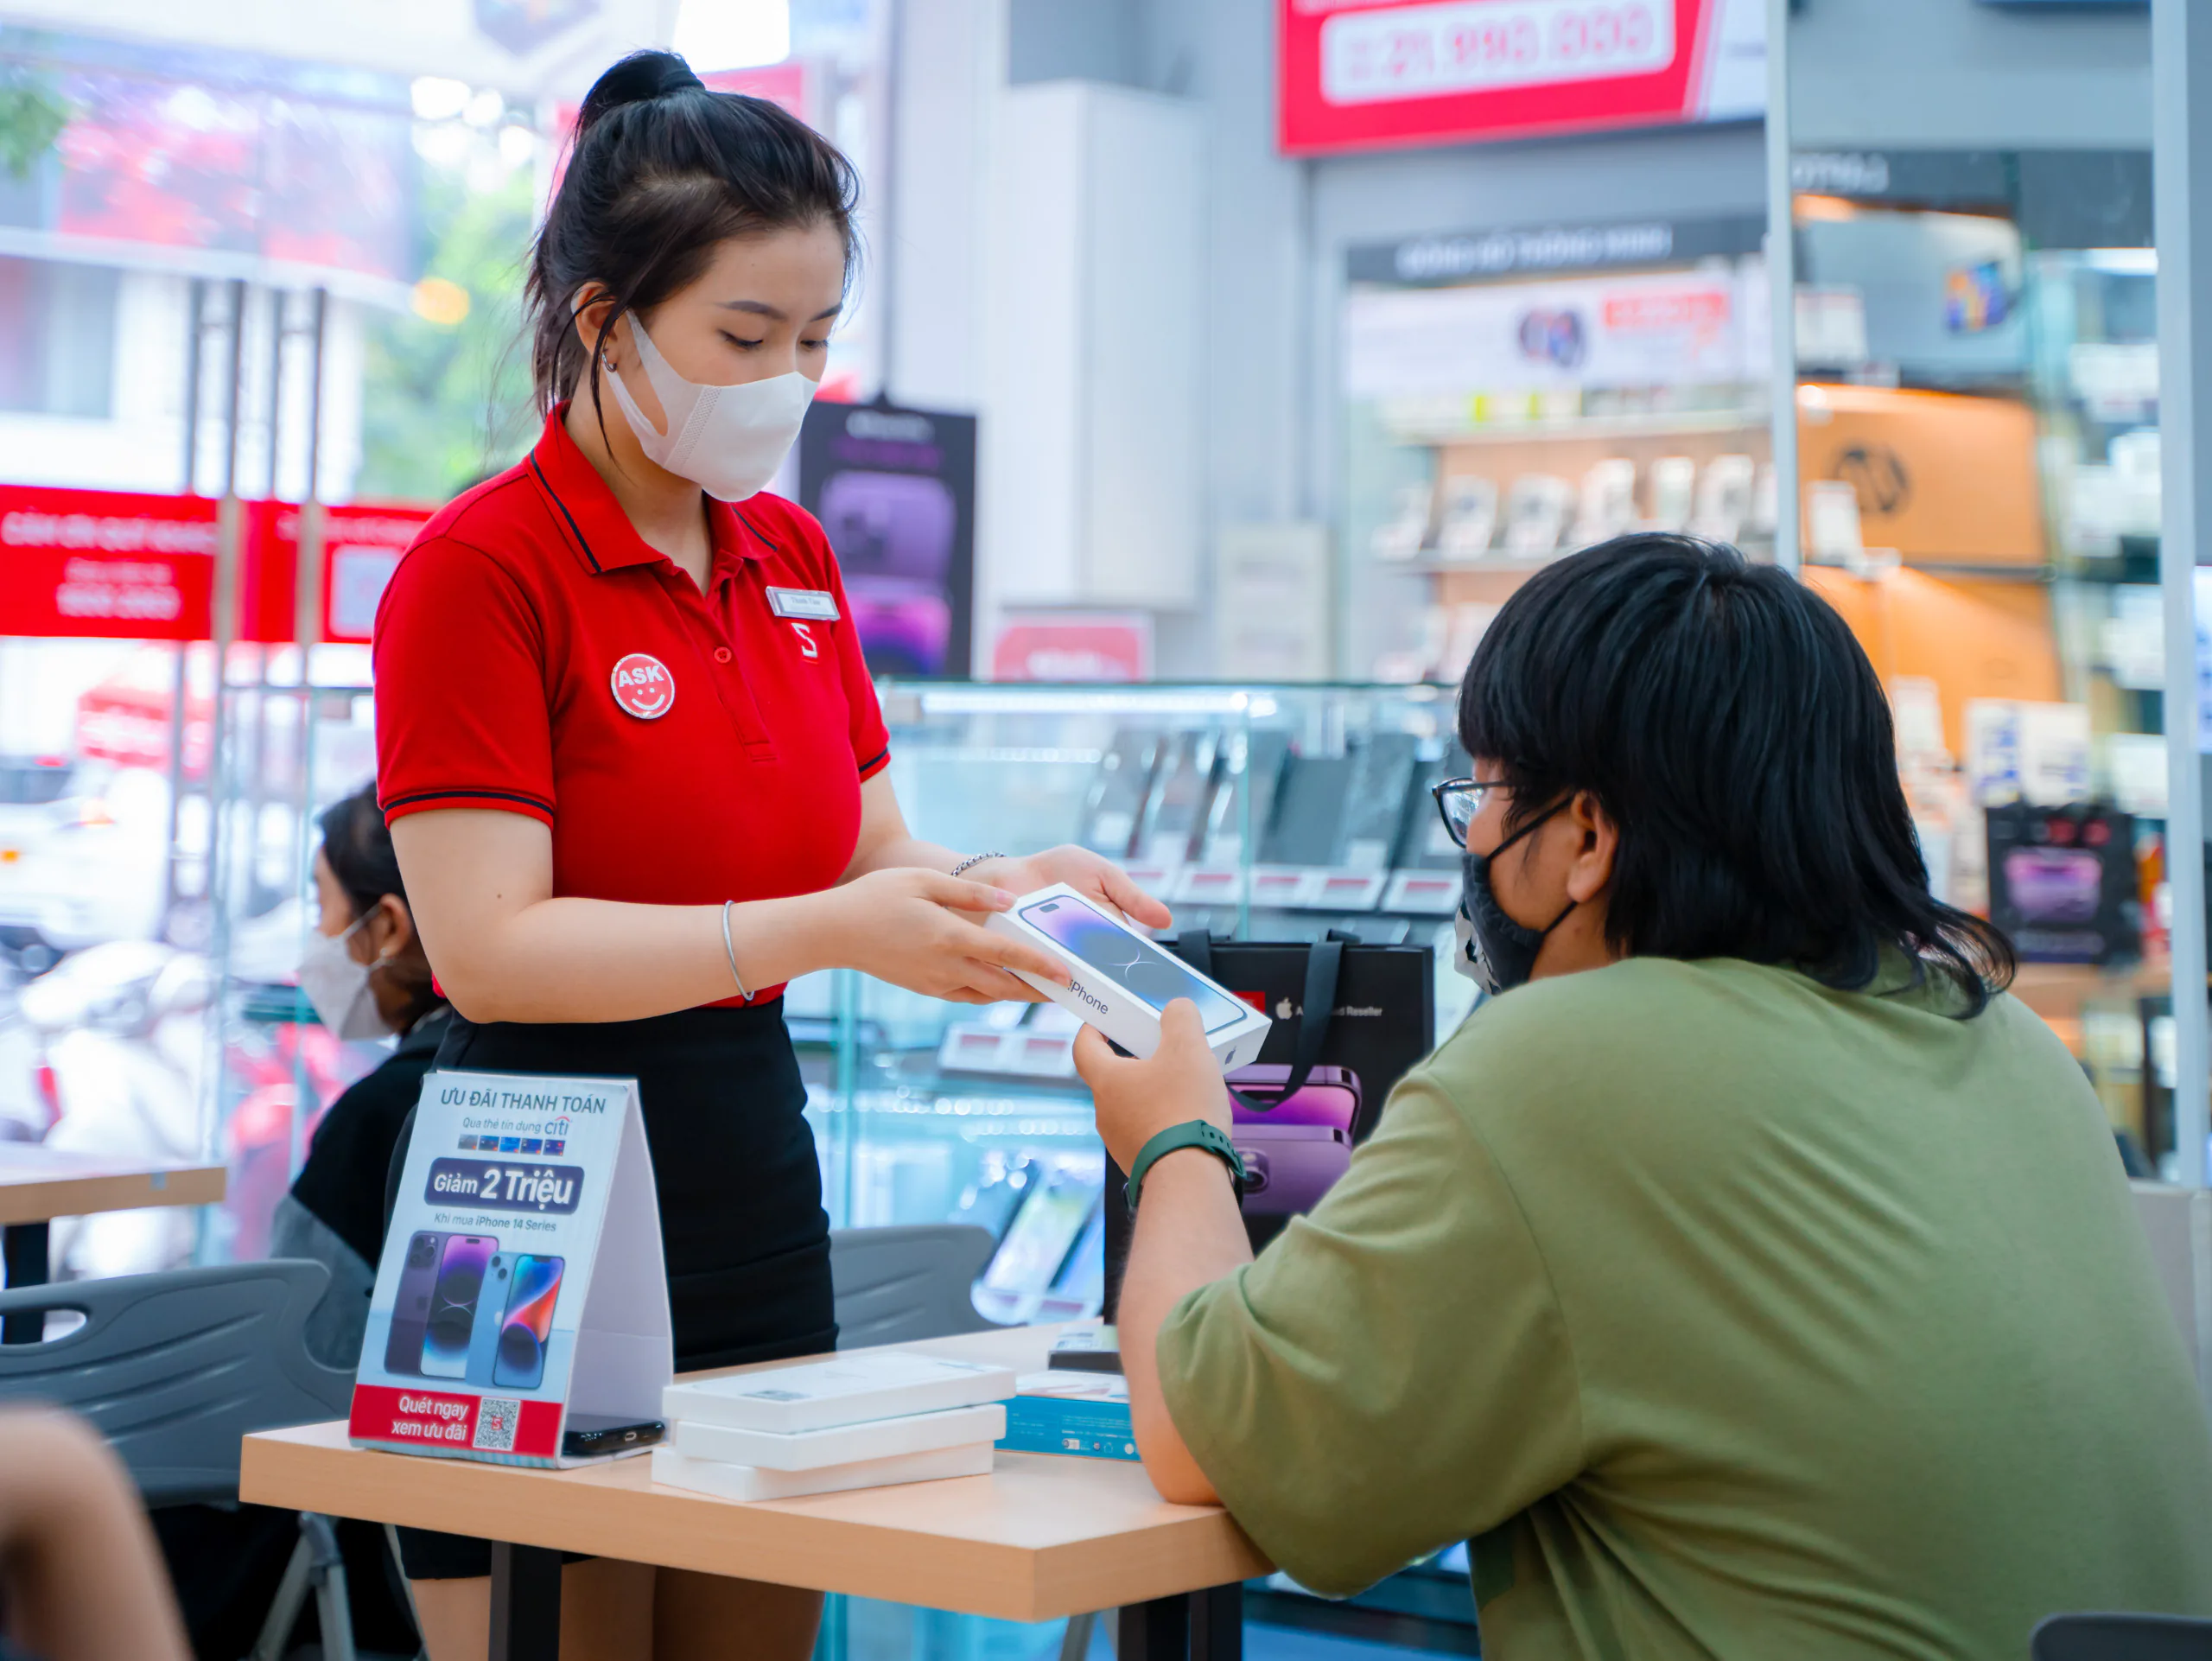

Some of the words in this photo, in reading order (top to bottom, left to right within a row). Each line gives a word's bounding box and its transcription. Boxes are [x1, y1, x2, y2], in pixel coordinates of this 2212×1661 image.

[619, 665, 664, 687] ASK
[1068, 979, 1109, 1015] iPhone
[1346, 1005, 1382, 1016] Reseller
[441, 1088, 466, 1105] ƯU
[469, 1089, 498, 1108] ĐÃI
[501, 1092, 558, 1111] THANH
[562, 1094, 606, 1113] TOÁN
[462, 1117, 481, 1129] Qua
[483, 1118, 499, 1130] thẻ
[501, 1120, 514, 1130] tín
[516, 1121, 541, 1134] dụng
[434, 1173, 479, 1194] Giảm
[480, 1168, 501, 1200] 2
[505, 1169, 573, 1210] Triệu
[434, 1212, 450, 1224] Khi
[452, 1216, 473, 1225] mua
[475, 1215, 510, 1229] iPhone
[512, 1219, 523, 1229] 14
[524, 1219, 556, 1231] Series
[398, 1396, 431, 1414] Quét
[434, 1402, 469, 1421] ngay
[391, 1421, 421, 1436] xem
[423, 1422, 442, 1439] ưu
[444, 1423, 467, 1441] đãi
